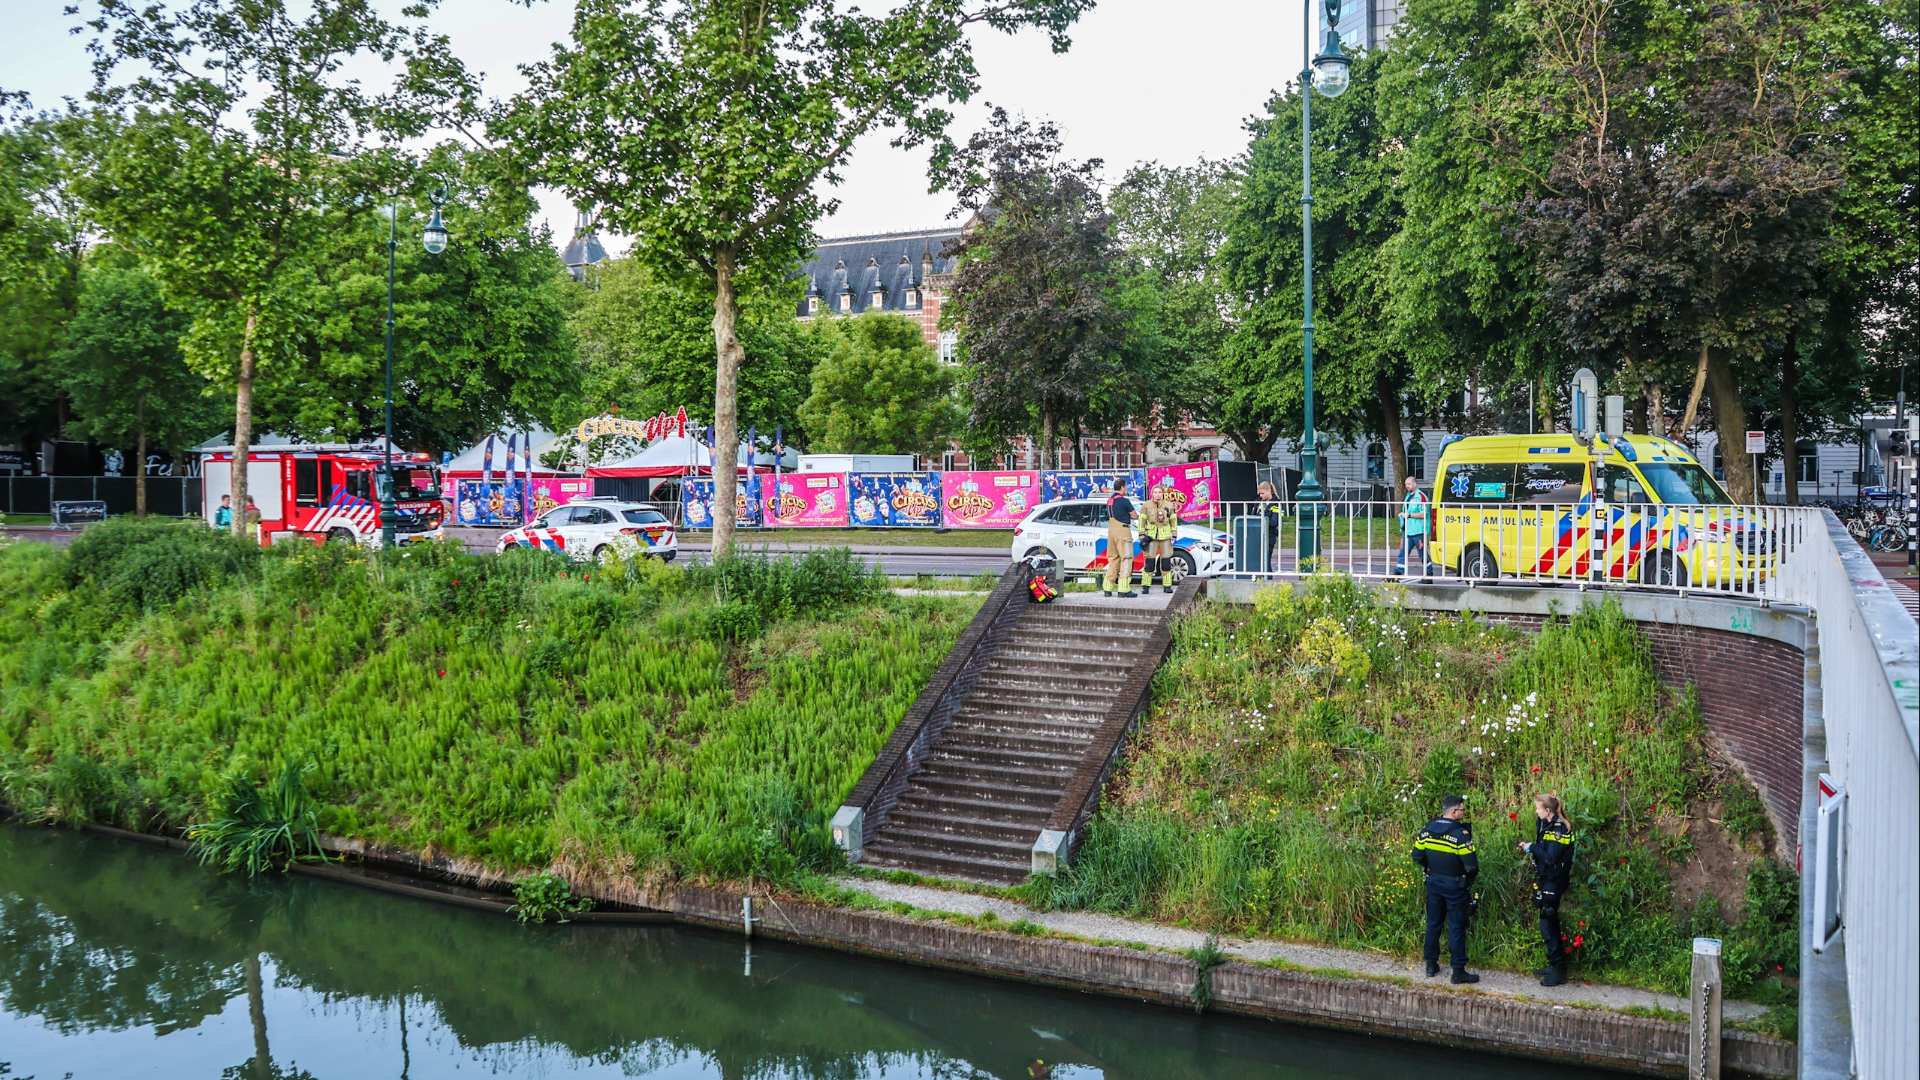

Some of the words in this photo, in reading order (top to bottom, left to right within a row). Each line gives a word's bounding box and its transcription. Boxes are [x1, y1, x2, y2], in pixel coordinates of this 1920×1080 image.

[767, 496, 806, 510] CRCUS
[893, 495, 937, 510] CIRCUS
[947, 495, 993, 511] CIRCUS
[1163, 490, 1186, 504] RCUS
[1064, 540, 1093, 548] POLITIE
